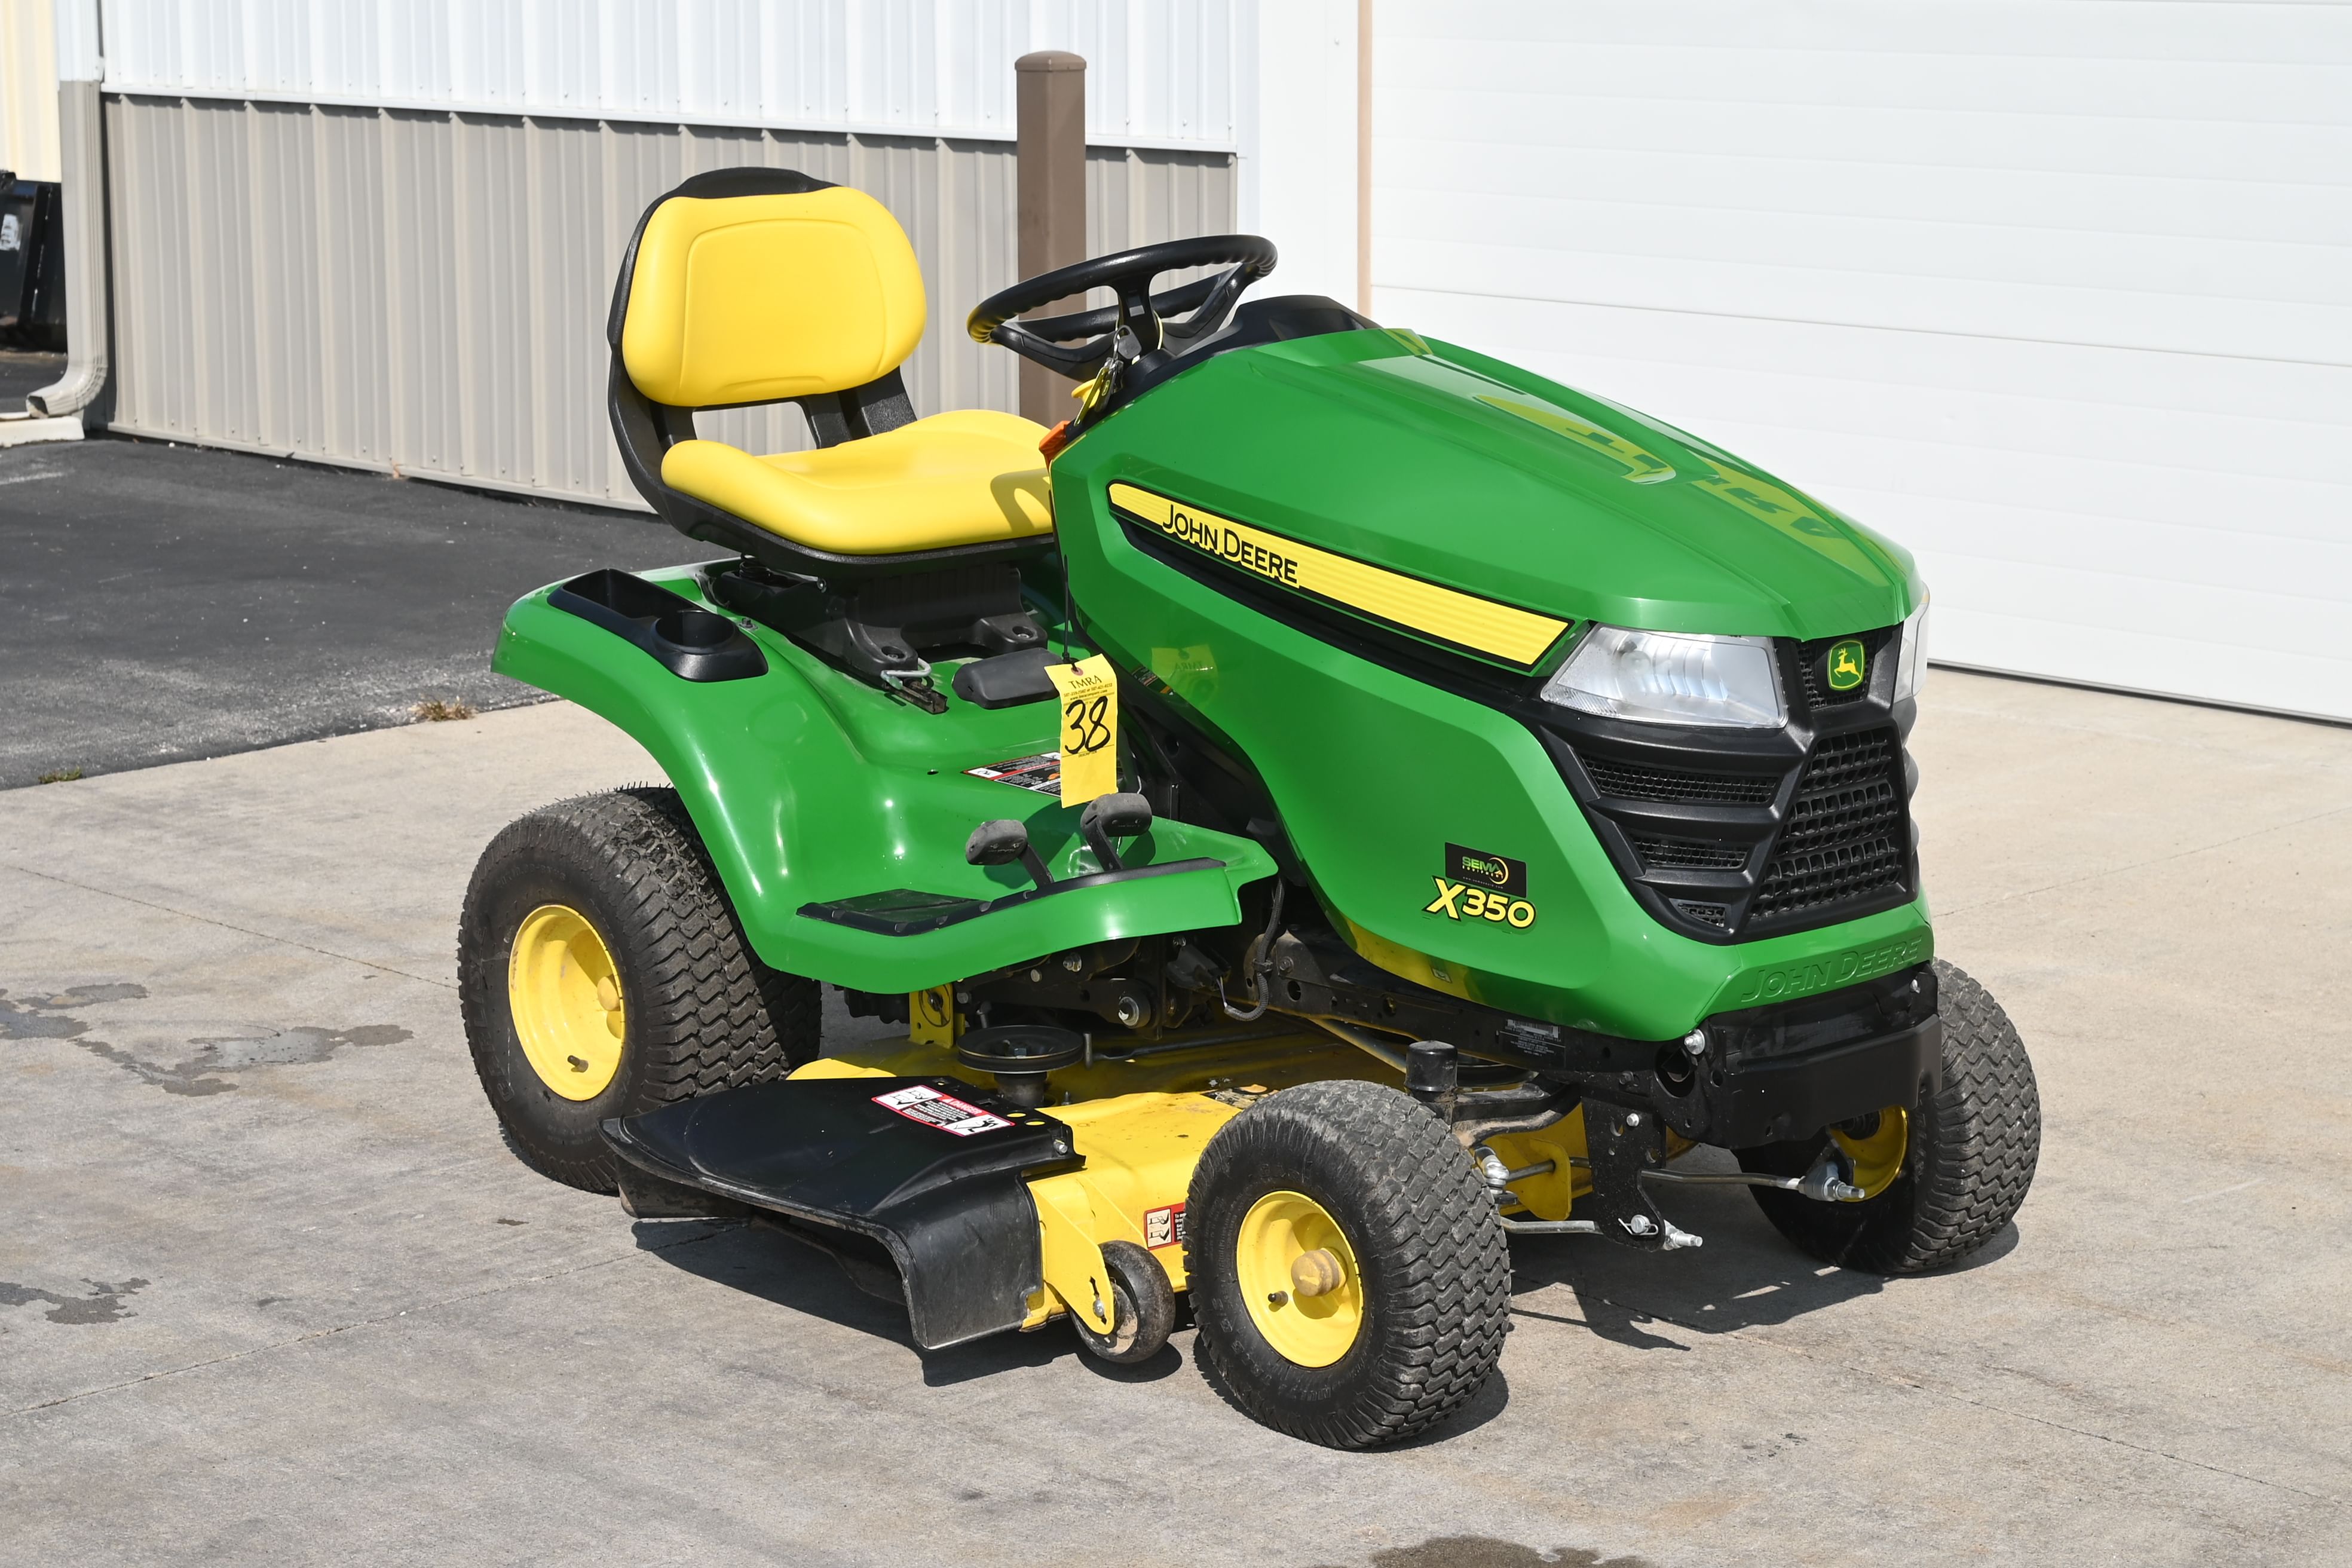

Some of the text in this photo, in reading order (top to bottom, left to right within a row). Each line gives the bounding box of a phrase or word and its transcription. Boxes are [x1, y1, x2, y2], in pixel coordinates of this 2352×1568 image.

[1162, 504, 1299, 587] JOHN DEERE
[1068, 675, 1102, 689] TMRA
[1064, 696, 1111, 755] 38
[1462, 856, 1502, 875] SEMA
[1422, 875, 1537, 930] X350
[1740, 935, 1922, 1003] JOHN DEERE
